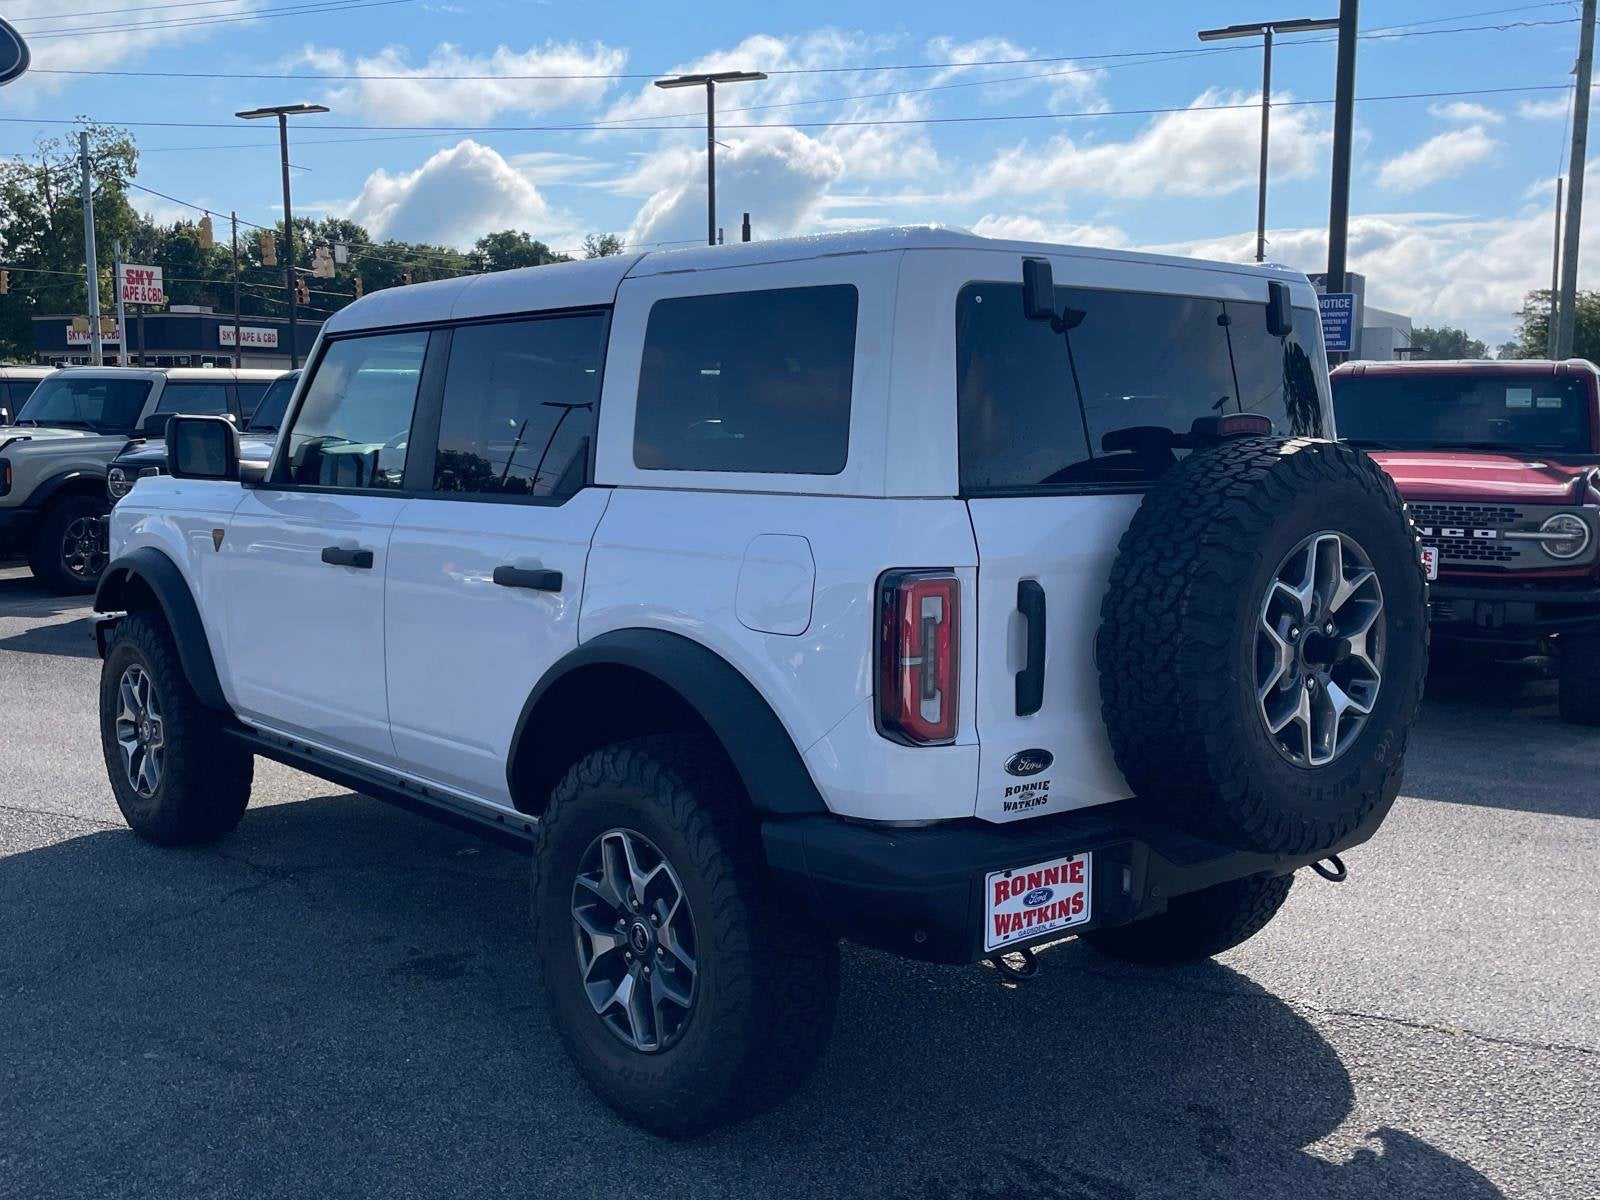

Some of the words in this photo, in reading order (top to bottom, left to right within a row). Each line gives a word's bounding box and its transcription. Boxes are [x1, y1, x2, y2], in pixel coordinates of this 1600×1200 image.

[126, 269, 154, 286] SKY
[141, 286, 147, 301] &
[147, 287, 162, 302] CBD
[1319, 299, 1351, 309] NOTICE
[222, 331, 236, 341] SKY
[257, 333, 262, 343] &
[263, 333, 277, 343] CBD
[1005, 780, 1050, 798] RONNIE
[1003, 794, 1048, 811] WATKINS
[994, 861, 1084, 907] RONNIE
[994, 892, 1084, 936] WATKINS
[1049, 922, 1057, 930] AL
